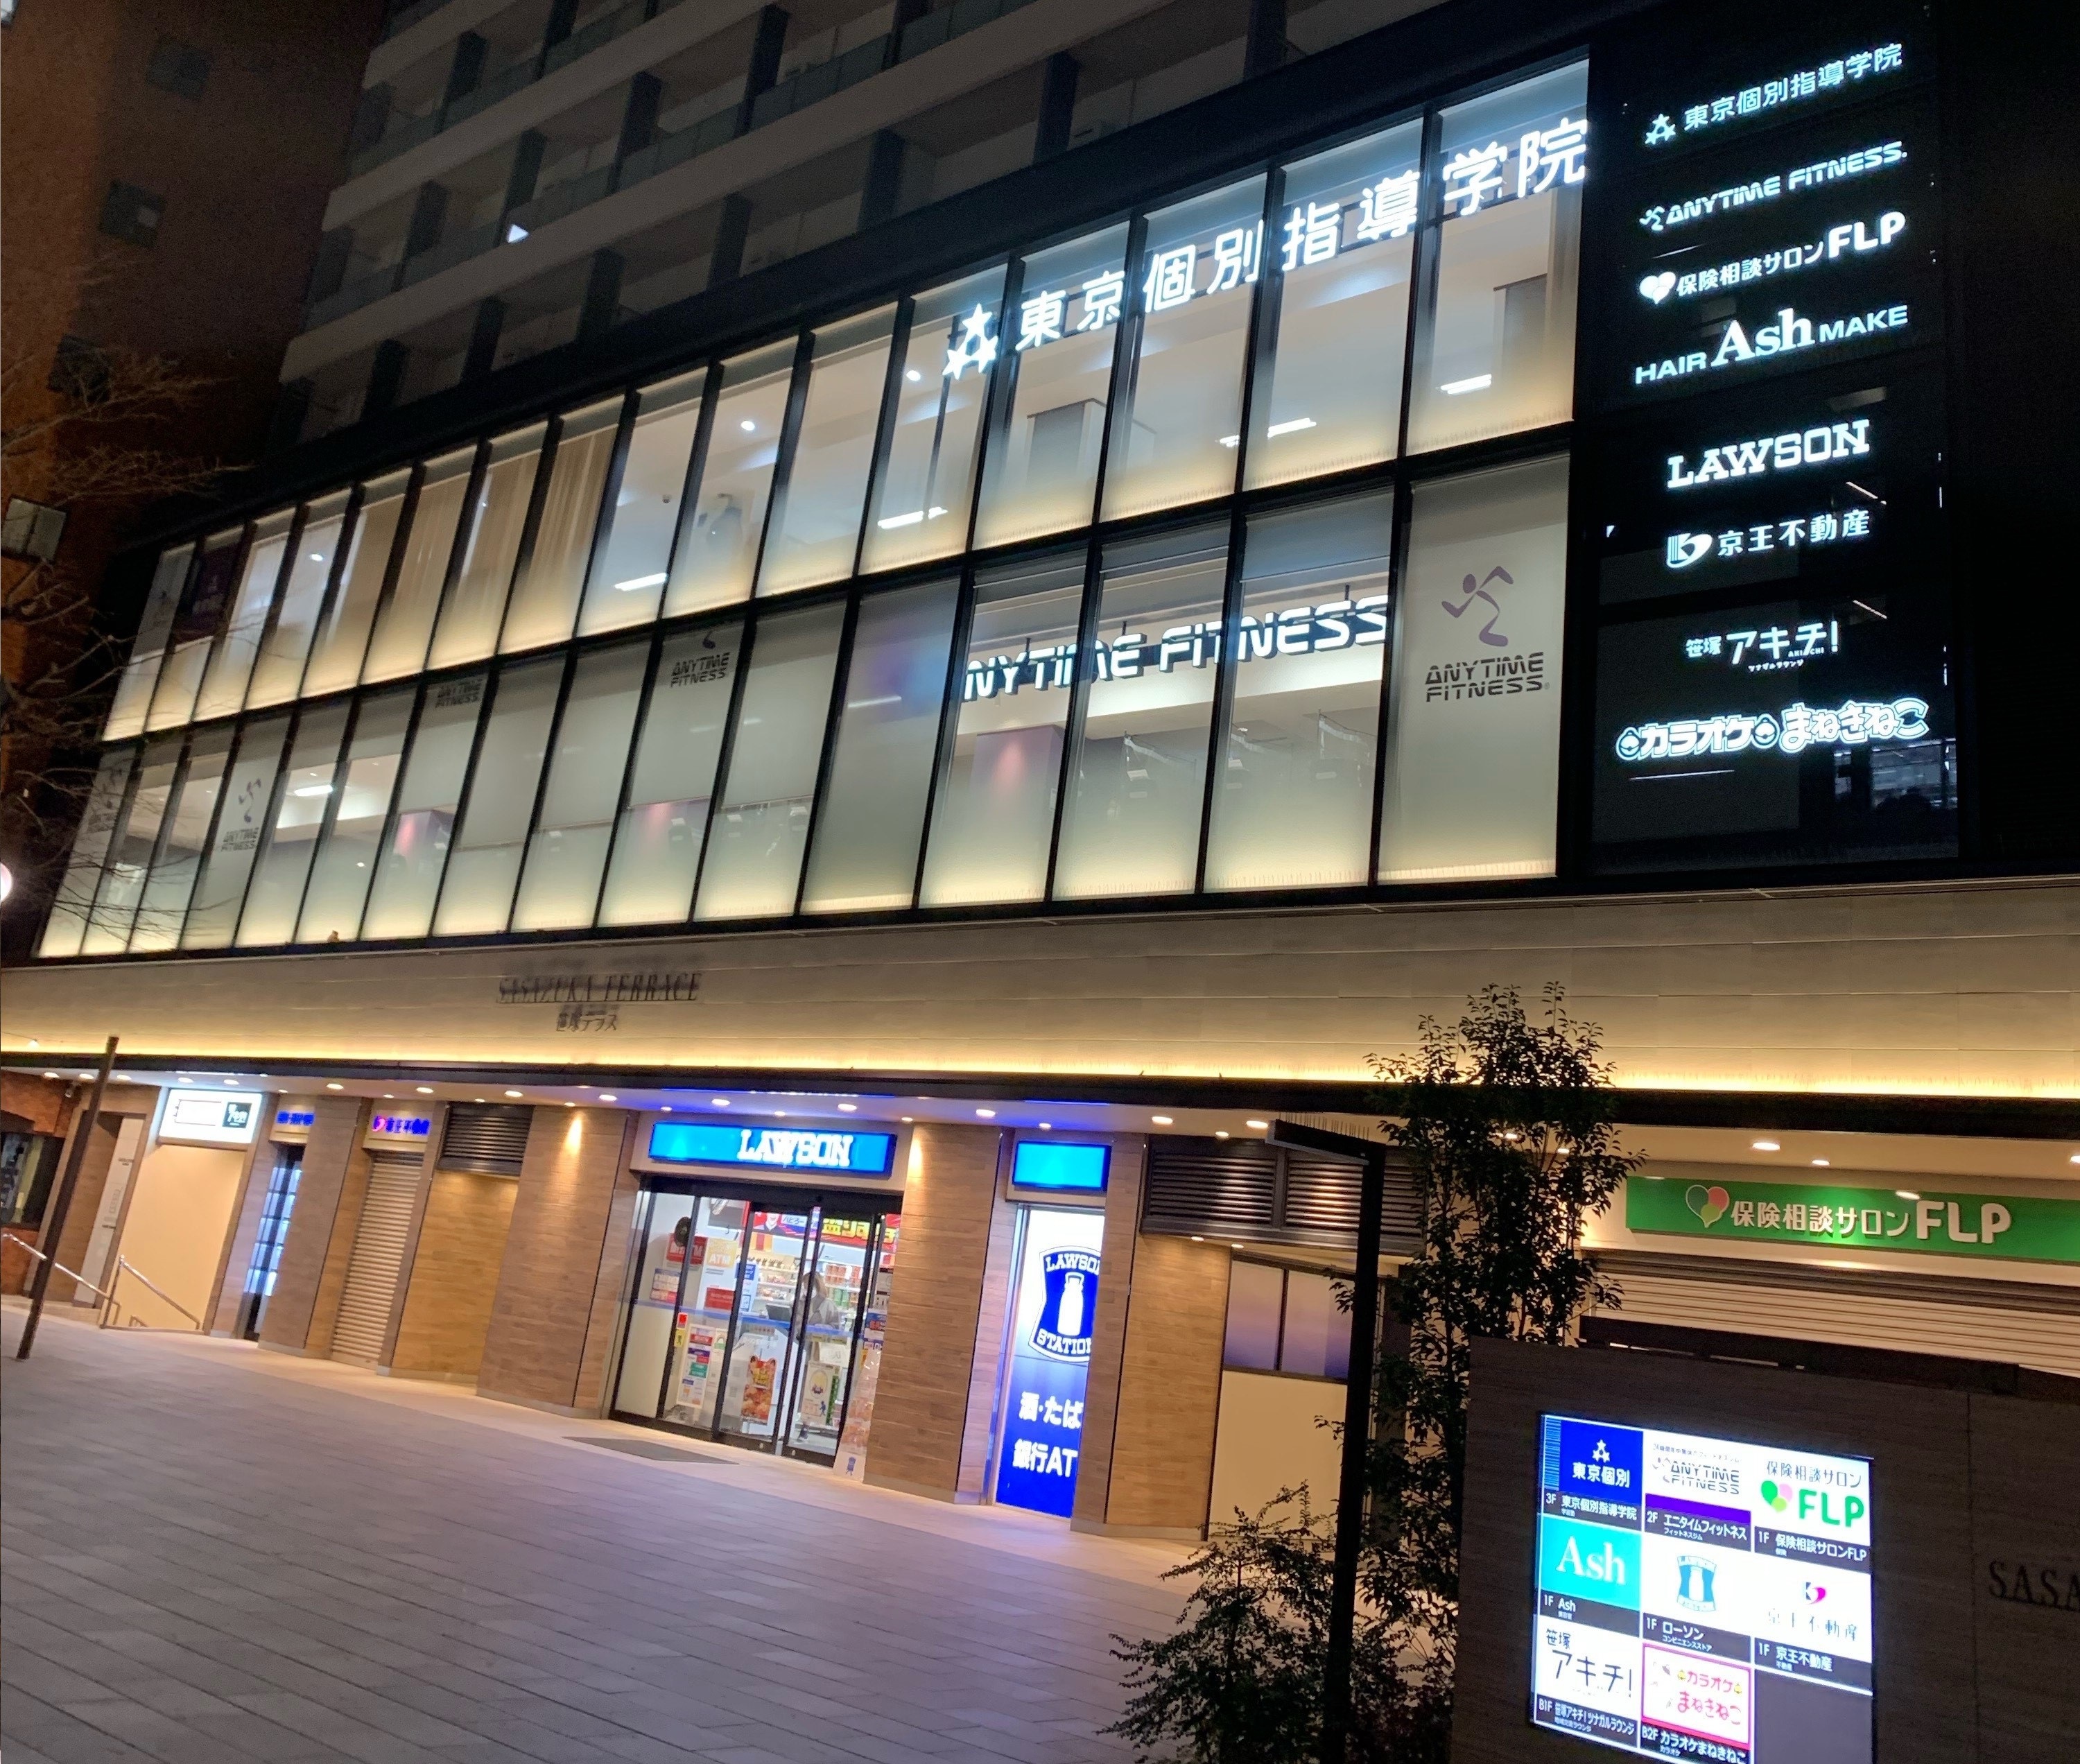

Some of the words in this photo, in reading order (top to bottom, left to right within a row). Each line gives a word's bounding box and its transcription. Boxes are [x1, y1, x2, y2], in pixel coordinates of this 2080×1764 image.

[1683, 42, 1903, 131] 東京個別指導学院
[1666, 176, 1780, 225] ANYTIME
[1016, 117, 1588, 351] 東京個別指導学院
[1636, 352, 1706, 384] HAIR
[1710, 309, 1815, 367] Ash
[1819, 305, 1908, 343] MAKE
[1667, 420, 1870, 487] LAWSON
[1717, 510, 1870, 556] 京王不動産
[1159, 594, 1388, 673] FITNESS
[1685, 636, 1722, 657] 笹塚
[1726, 621, 1838, 664] アキチ!
[670, 668, 726, 688] FITNESS
[671, 652, 730, 676] ANYTIME
[1425, 652, 1543, 684] ANYTIME
[1426, 674, 1543, 702] FITNESS
[1778, 697, 1929, 754] まねきねこ
[737, 1130, 853, 1167] LAWSON
[1572, 1461, 1630, 1489] 東京個別
[1671, 1460, 1739, 1482] ANYTIME
[1672, 1475, 1739, 1494] FITNESS
[1767, 1461, 1861, 1487] 保険相談サロン
[1546, 1492, 1557, 1504] 3F
[1561, 1495, 1637, 1521] 東京個別指導学院
[1799, 1489, 1864, 1528] FLP
[1647, 1511, 1658, 1523] 2F
[1663, 1514, 1747, 1541] エニタイムフィットネス
[1555, 1535, 1626, 1584] Ash
[1759, 1531, 1769, 1544] 1F
[1776, 1533, 1866, 1561] 保険相談サロンFLP
[1544, 1594, 1553, 1607] 1F
[1558, 1598, 1576, 1612] Ash
[1546, 1628, 1570, 1649] 笹塚
[1647, 1617, 1657, 1629] 1F
[1663, 1621, 1704, 1640] ローソン
[1759, 1643, 1769, 1656] 1F
[1776, 1646, 1832, 1672] 京王不動産
[1688, 1671, 1733, 1692] カラオケ
[1539, 1698, 1552, 1712] B1F
[1678, 1690, 1741, 1725] まねきねこ
[1642, 1725, 1658, 1740] B2F
[1660, 1731, 1746, 1764] カラオケまねきねこ
